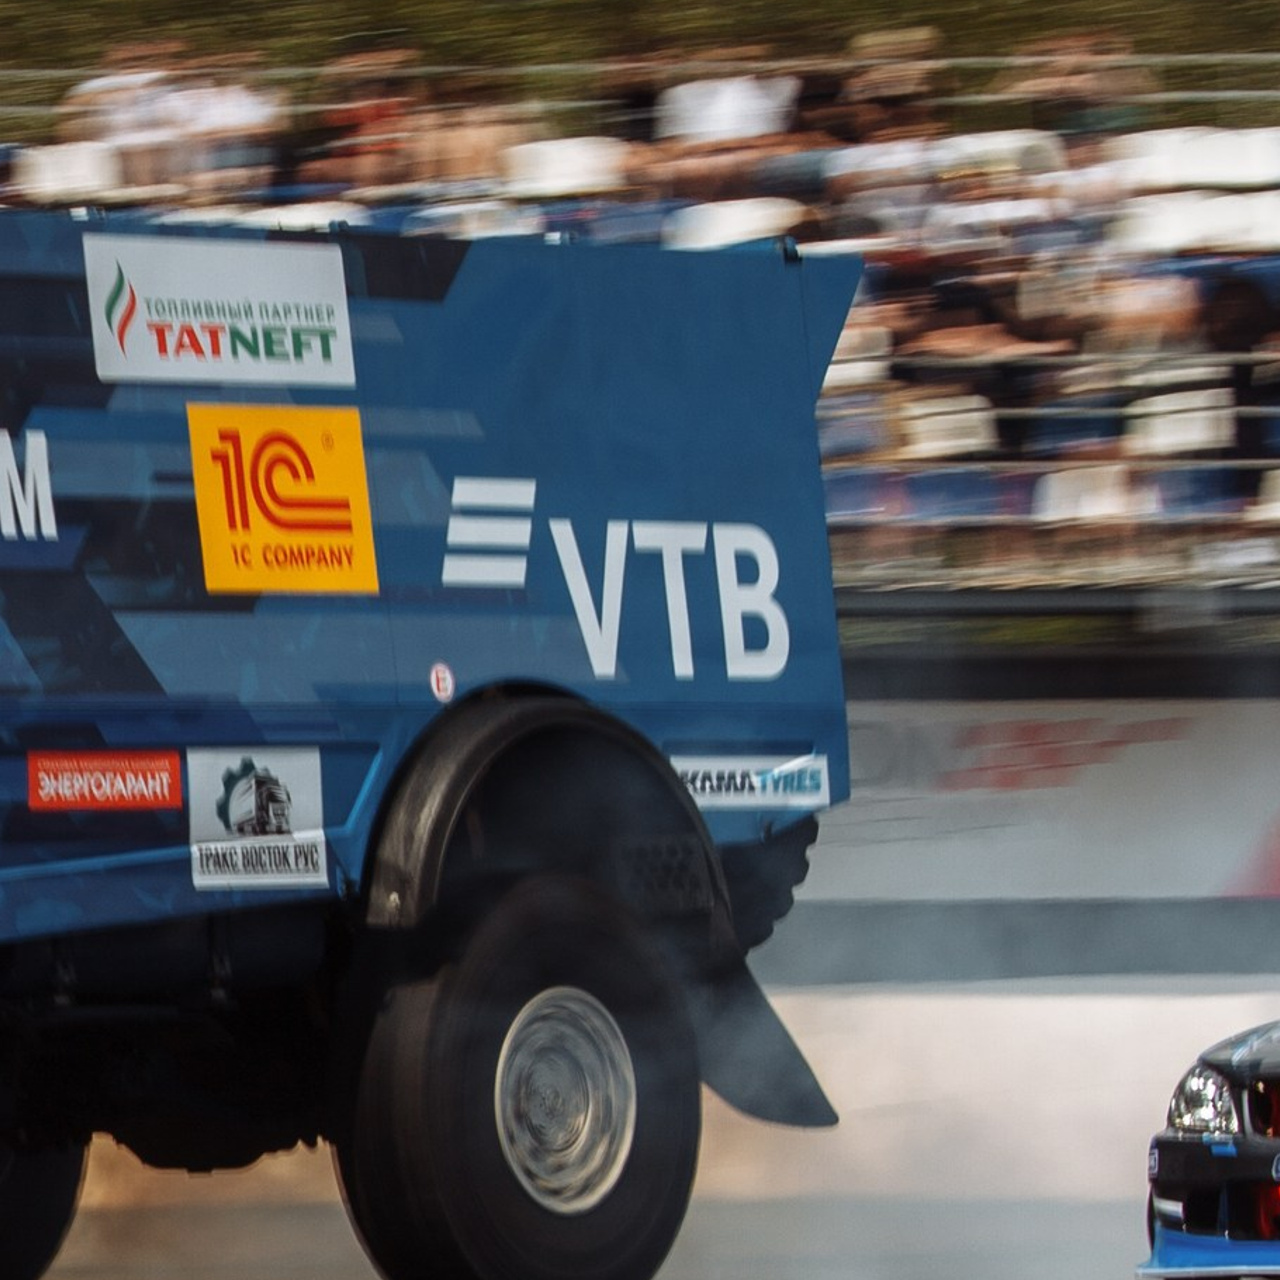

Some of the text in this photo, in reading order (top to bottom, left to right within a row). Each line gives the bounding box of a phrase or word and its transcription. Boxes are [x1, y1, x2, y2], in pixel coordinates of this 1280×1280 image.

[144, 297, 336, 323] ТОПЛИВНЫЙ ПАРТНЕР
[146, 322, 338, 365] TATNEFT
[262, 543, 355, 574] COMPANY
[548, 517, 791, 682] VTB
[37, 771, 171, 802] ЭНЕРГОГАРАНТ
[197, 841, 320, 876] ТРАКС ВОСТОК РУС
